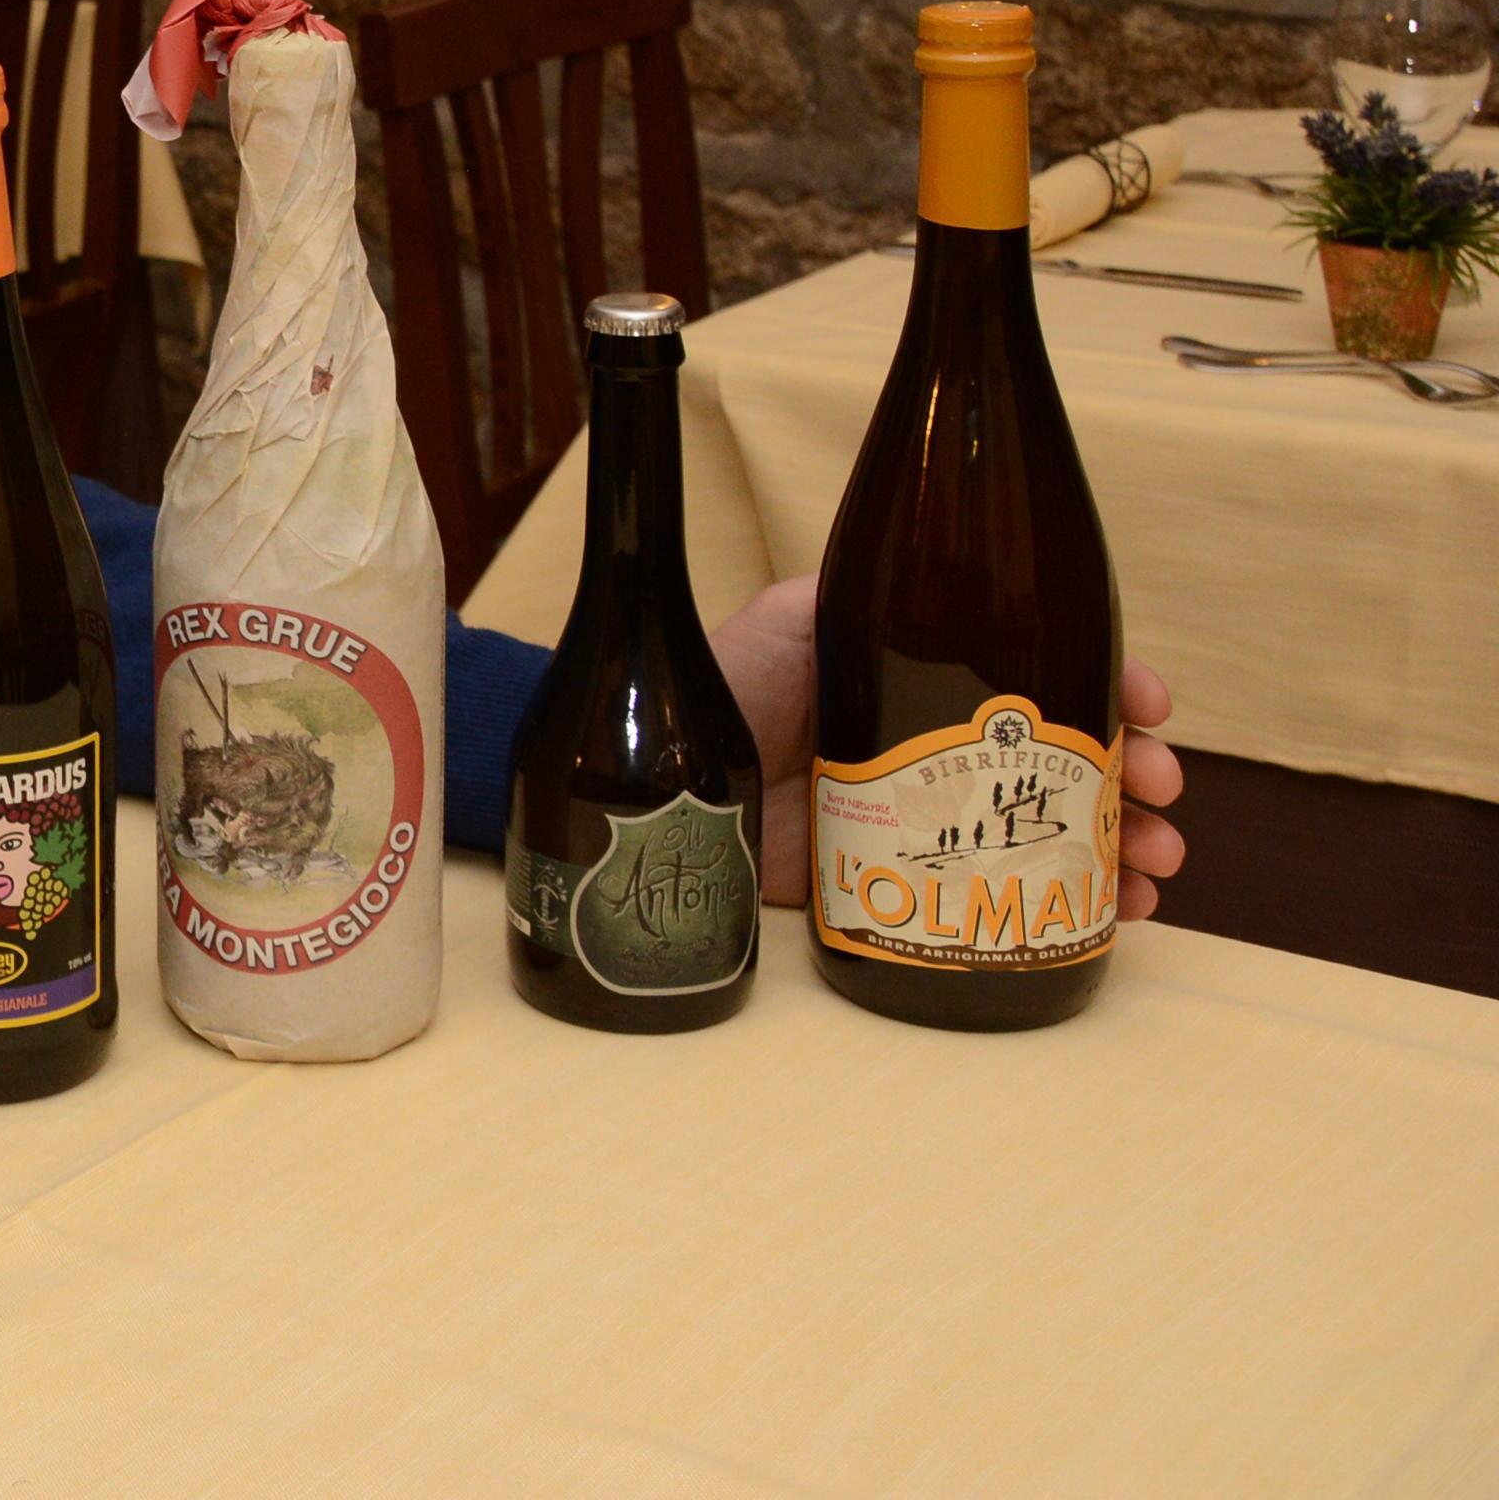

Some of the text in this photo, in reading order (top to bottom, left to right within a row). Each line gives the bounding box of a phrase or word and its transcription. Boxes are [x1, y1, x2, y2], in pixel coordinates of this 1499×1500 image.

[166, 606, 367, 675] REX GRUE
[918, 750, 1084, 787] BIRRIFICIO
[842, 811, 899, 828] conservanti
[847, 797, 892, 815] Naturale
[186, 820, 415, 970] MONTEGIOCO
[867, 934, 1100, 962] BIRRA ARTIGIANALE DELLA VAL
